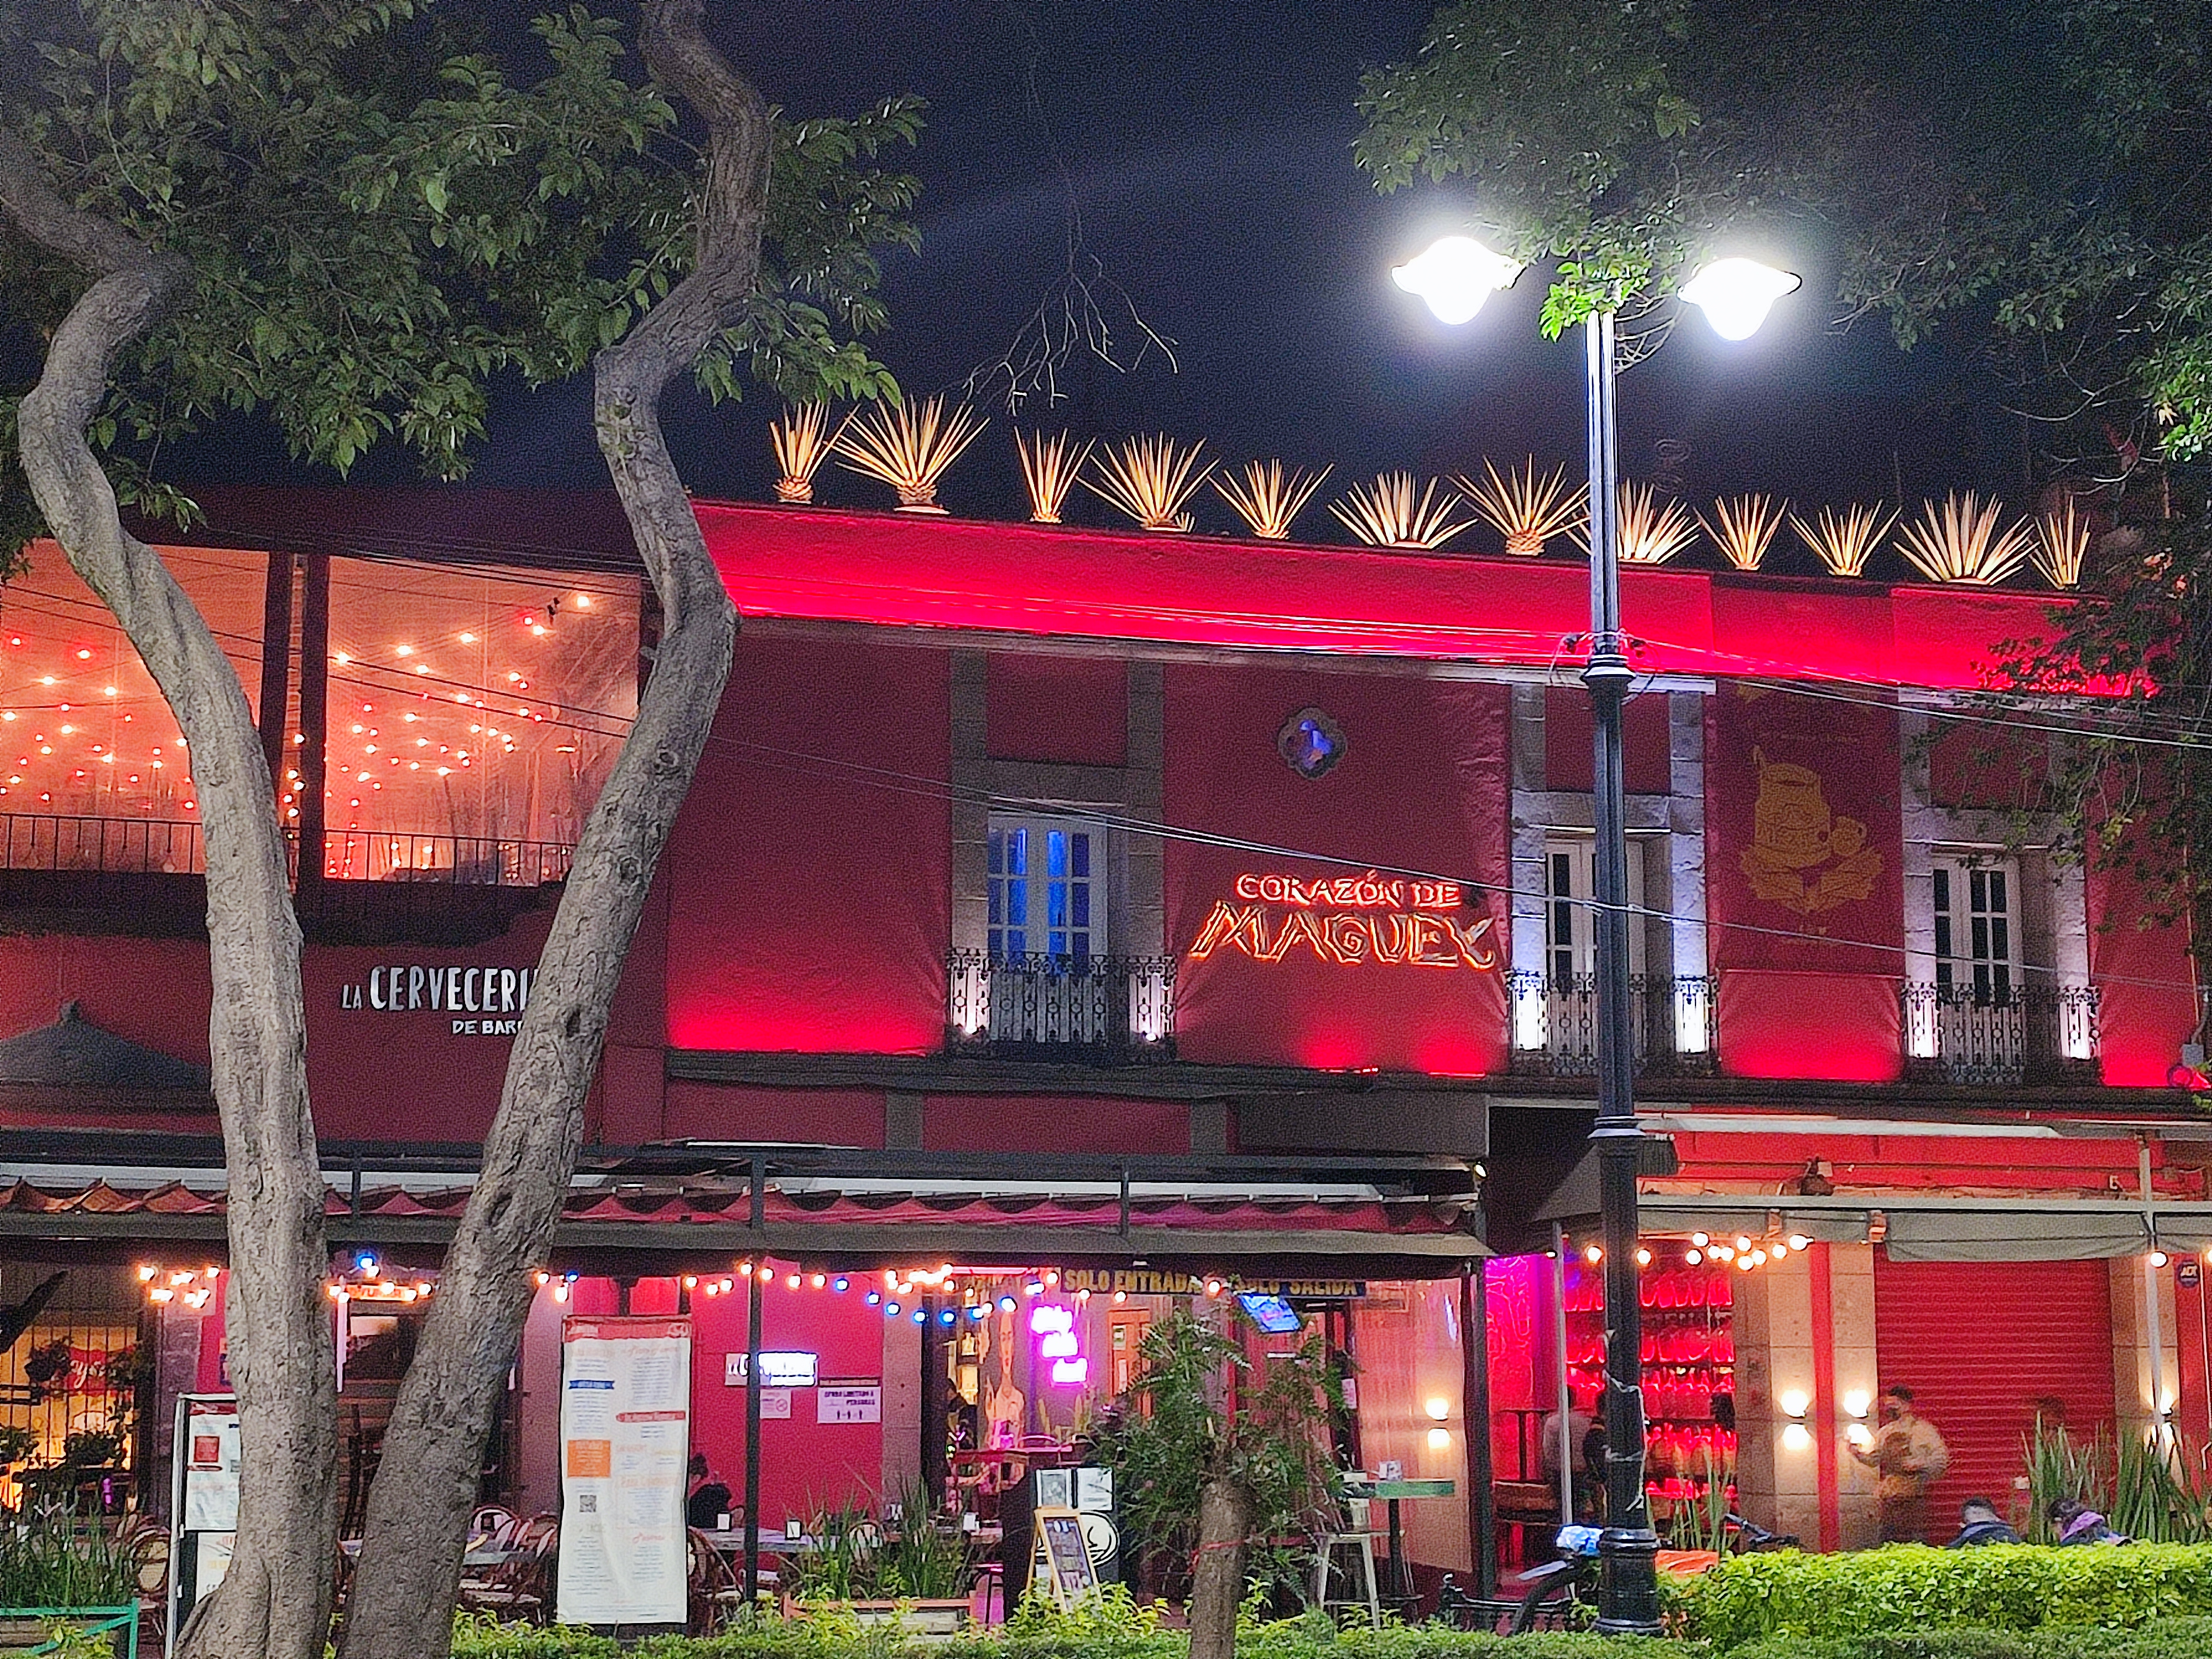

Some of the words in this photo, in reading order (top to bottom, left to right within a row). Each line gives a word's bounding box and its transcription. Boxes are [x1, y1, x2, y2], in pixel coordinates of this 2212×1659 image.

[1237, 869, 1404, 909] CORAZÓN
[1412, 880, 1462, 908] DE
[1188, 898, 1495, 971] MAGUEY
[342, 984, 362, 1009] LA
[369, 966, 539, 1013] CERVECERI
[452, 1020, 477, 1035] DE
[1065, 1269, 1110, 1292] SOLO
